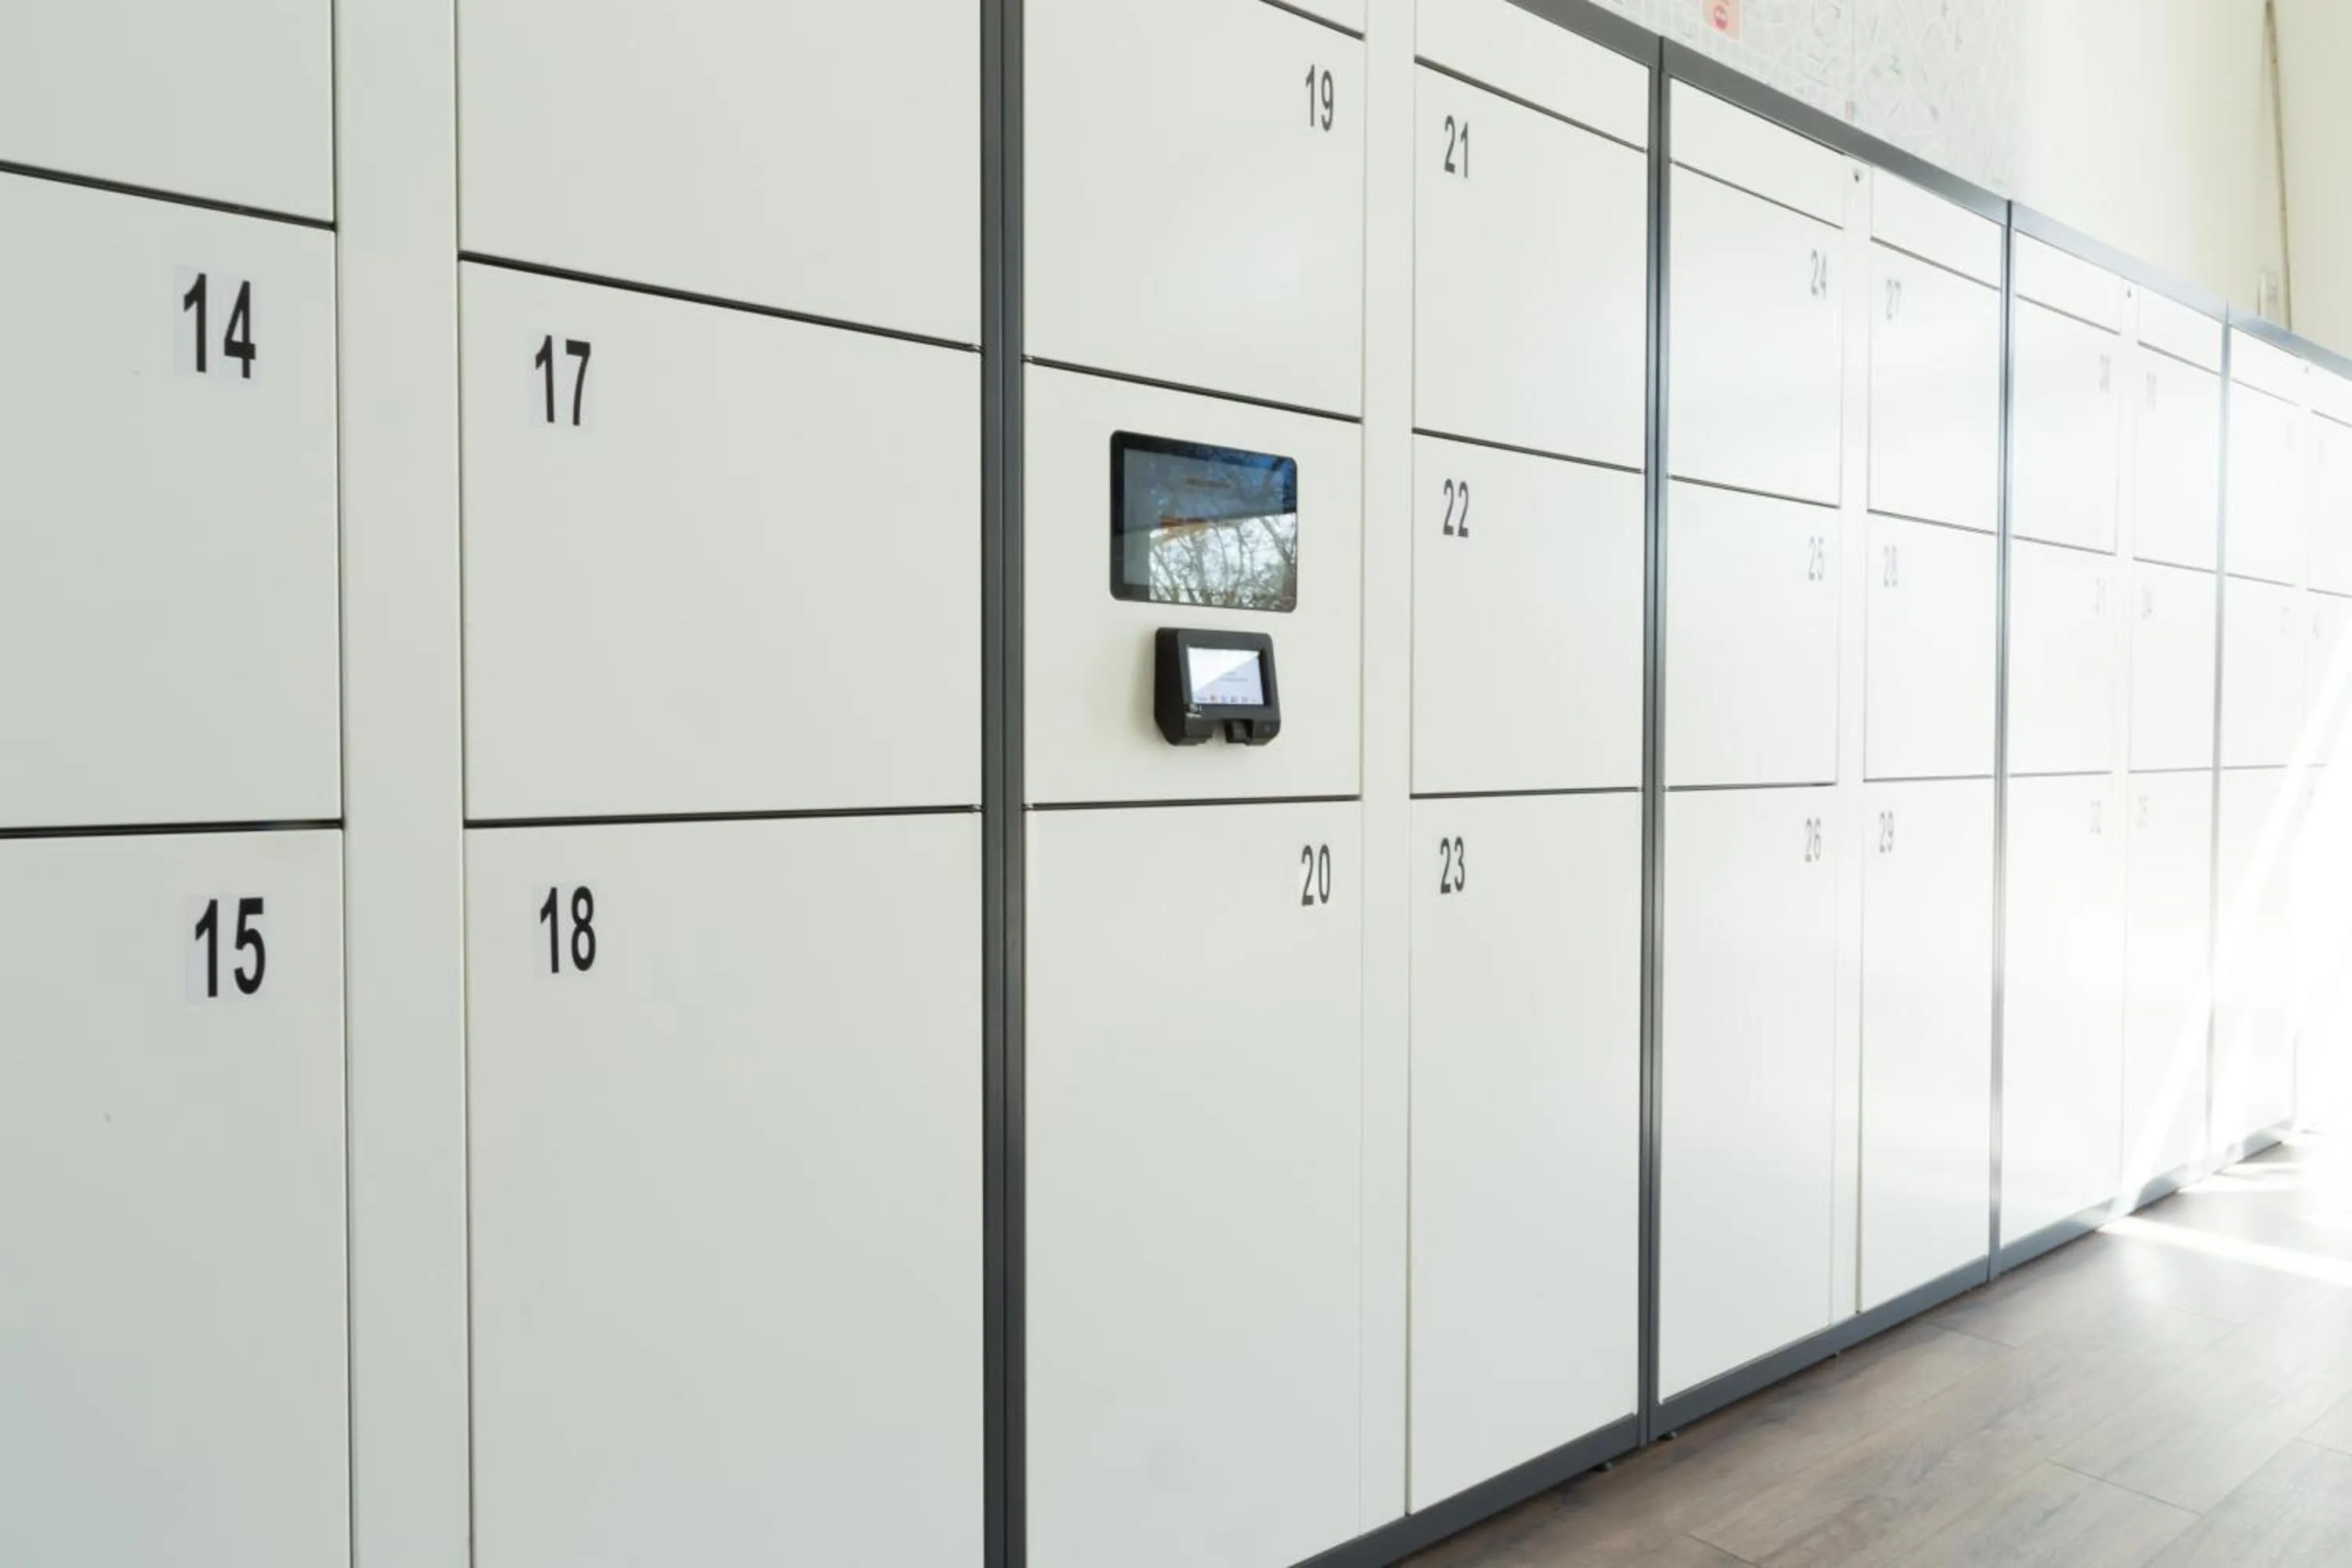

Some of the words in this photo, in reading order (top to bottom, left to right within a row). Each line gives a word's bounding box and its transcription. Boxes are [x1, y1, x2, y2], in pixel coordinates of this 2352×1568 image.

[1306, 64, 1335, 132] 19
[1444, 115, 1469, 180] 21
[1810, 249, 1828, 299] 24
[183, 273, 257, 380] 14
[535, 336, 592, 427] 17
[1443, 479, 1470, 539] 22
[1808, 535, 1826, 582] 25
[1806, 818, 1822, 863] 26
[1878, 811, 1895, 855] 29
[1301, 844, 1332, 908] 20
[1440, 837, 1466, 895] 23
[195, 898, 267, 999] 15
[540, 886, 597, 975] 18
